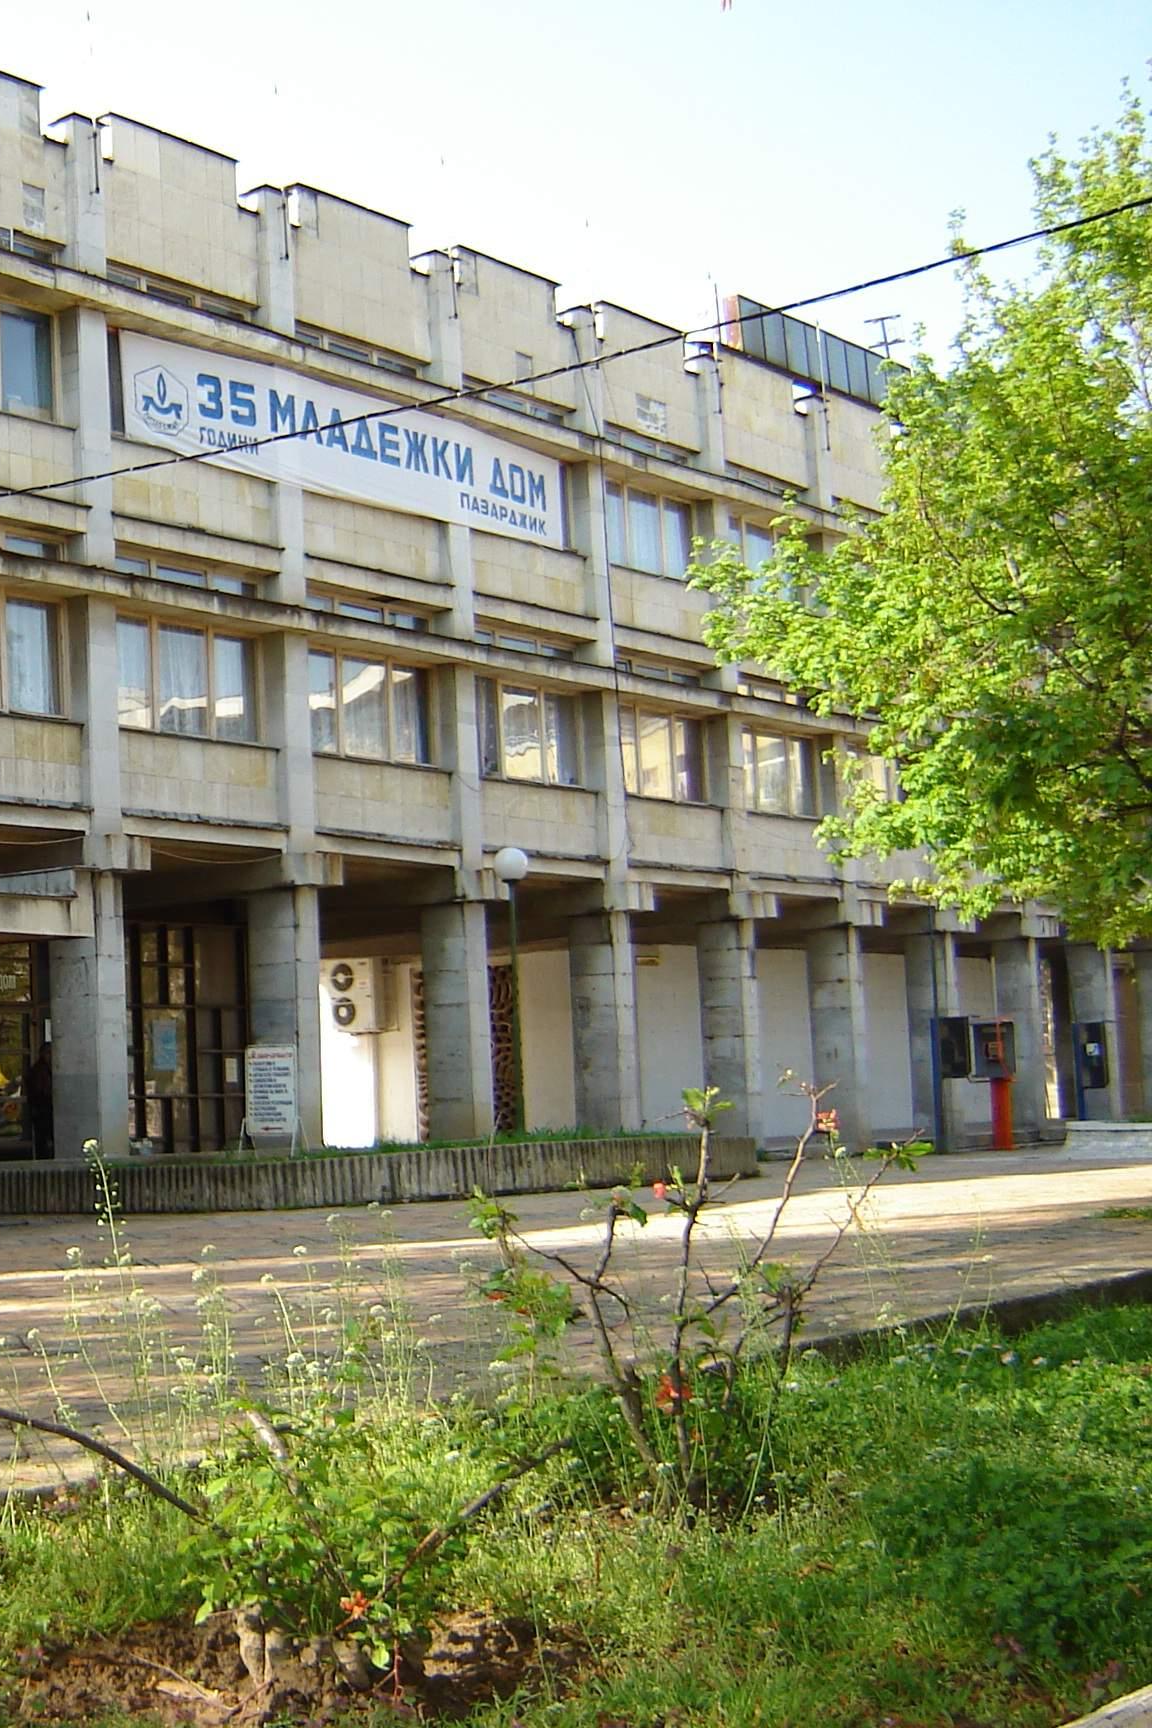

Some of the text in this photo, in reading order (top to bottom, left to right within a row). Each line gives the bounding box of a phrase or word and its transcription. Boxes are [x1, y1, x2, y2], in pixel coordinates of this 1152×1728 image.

[197, 373, 546, 512] 35 МЛАДЕЖКИ ДОМ
[200, 427, 259, 456] ГОДИНИ
[460, 492, 547, 536] ПАЗАРДЖИК
